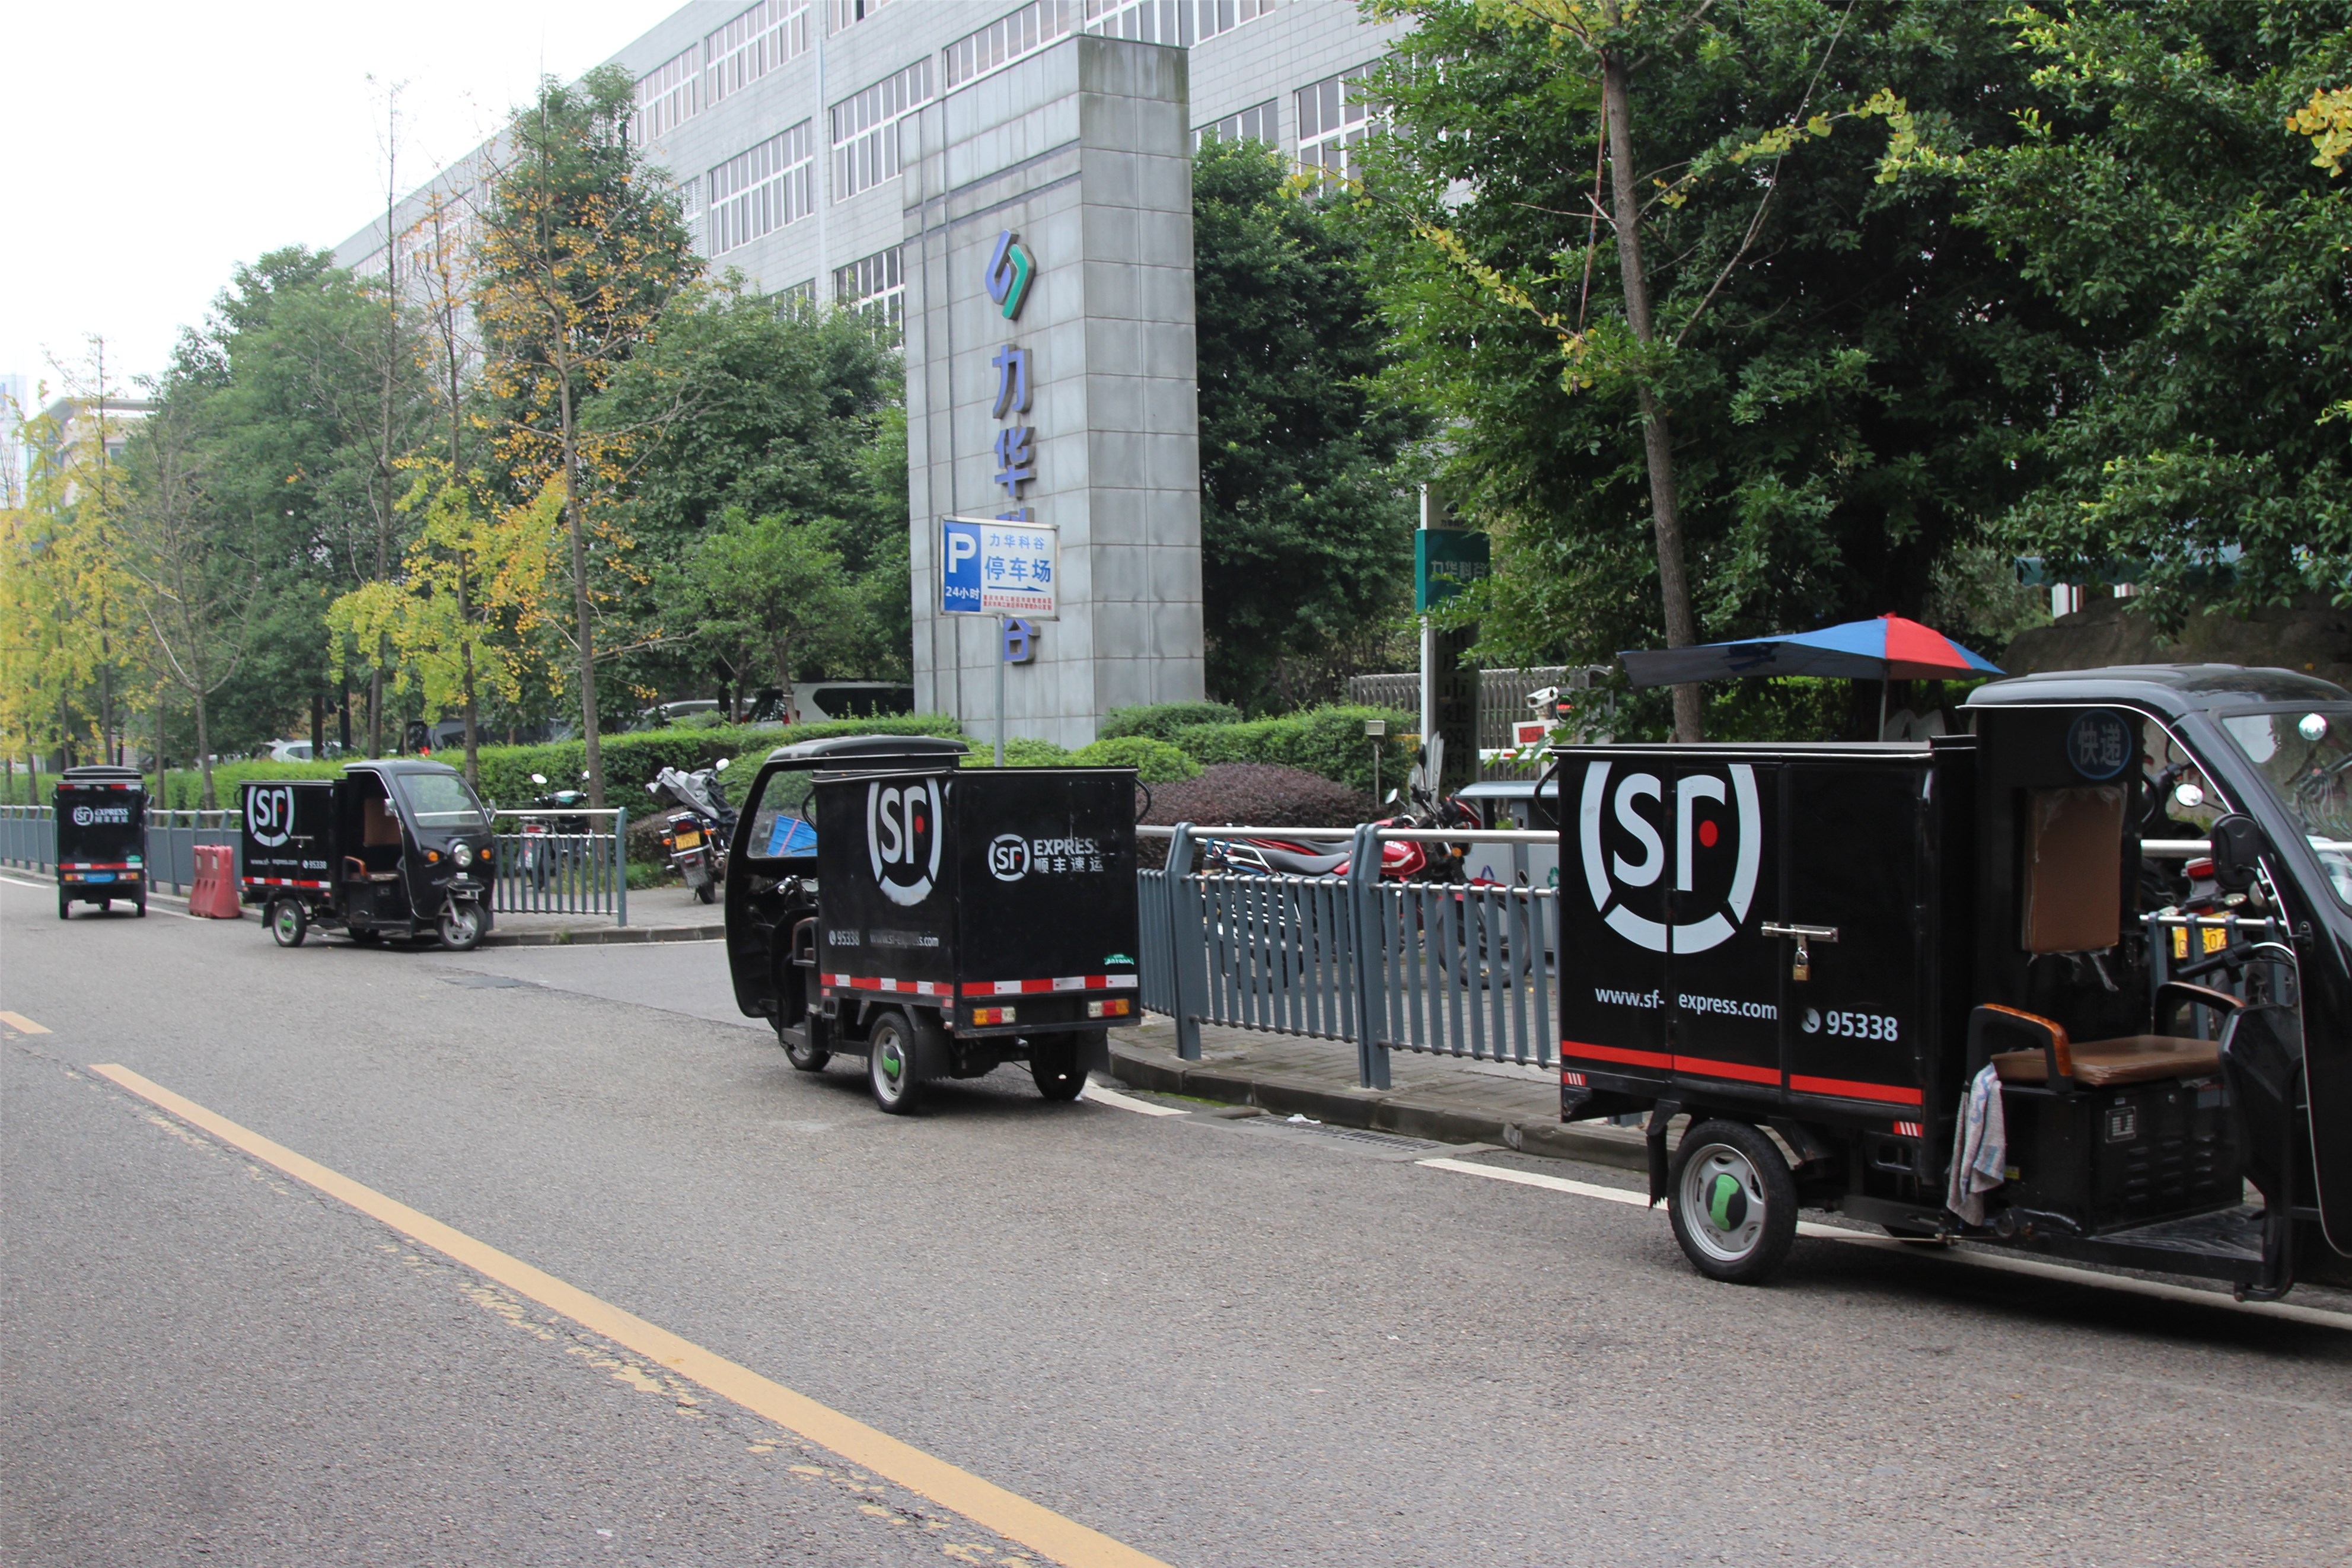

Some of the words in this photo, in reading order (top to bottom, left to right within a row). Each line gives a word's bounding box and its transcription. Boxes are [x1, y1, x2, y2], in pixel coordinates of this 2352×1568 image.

[992, 343, 1039, 664] 力华谷
[948, 532, 977, 573] P
[989, 533, 1044, 550] 力华科谷
[985, 556, 1051, 583] 停车场
[945, 586, 980, 601] 24小时
[2077, 721, 2121, 766] 快递
[1034, 856, 1104, 874] 顺丰速运
[837, 930, 860, 946] 95338
[1826, 1010, 1898, 1041] 95338
